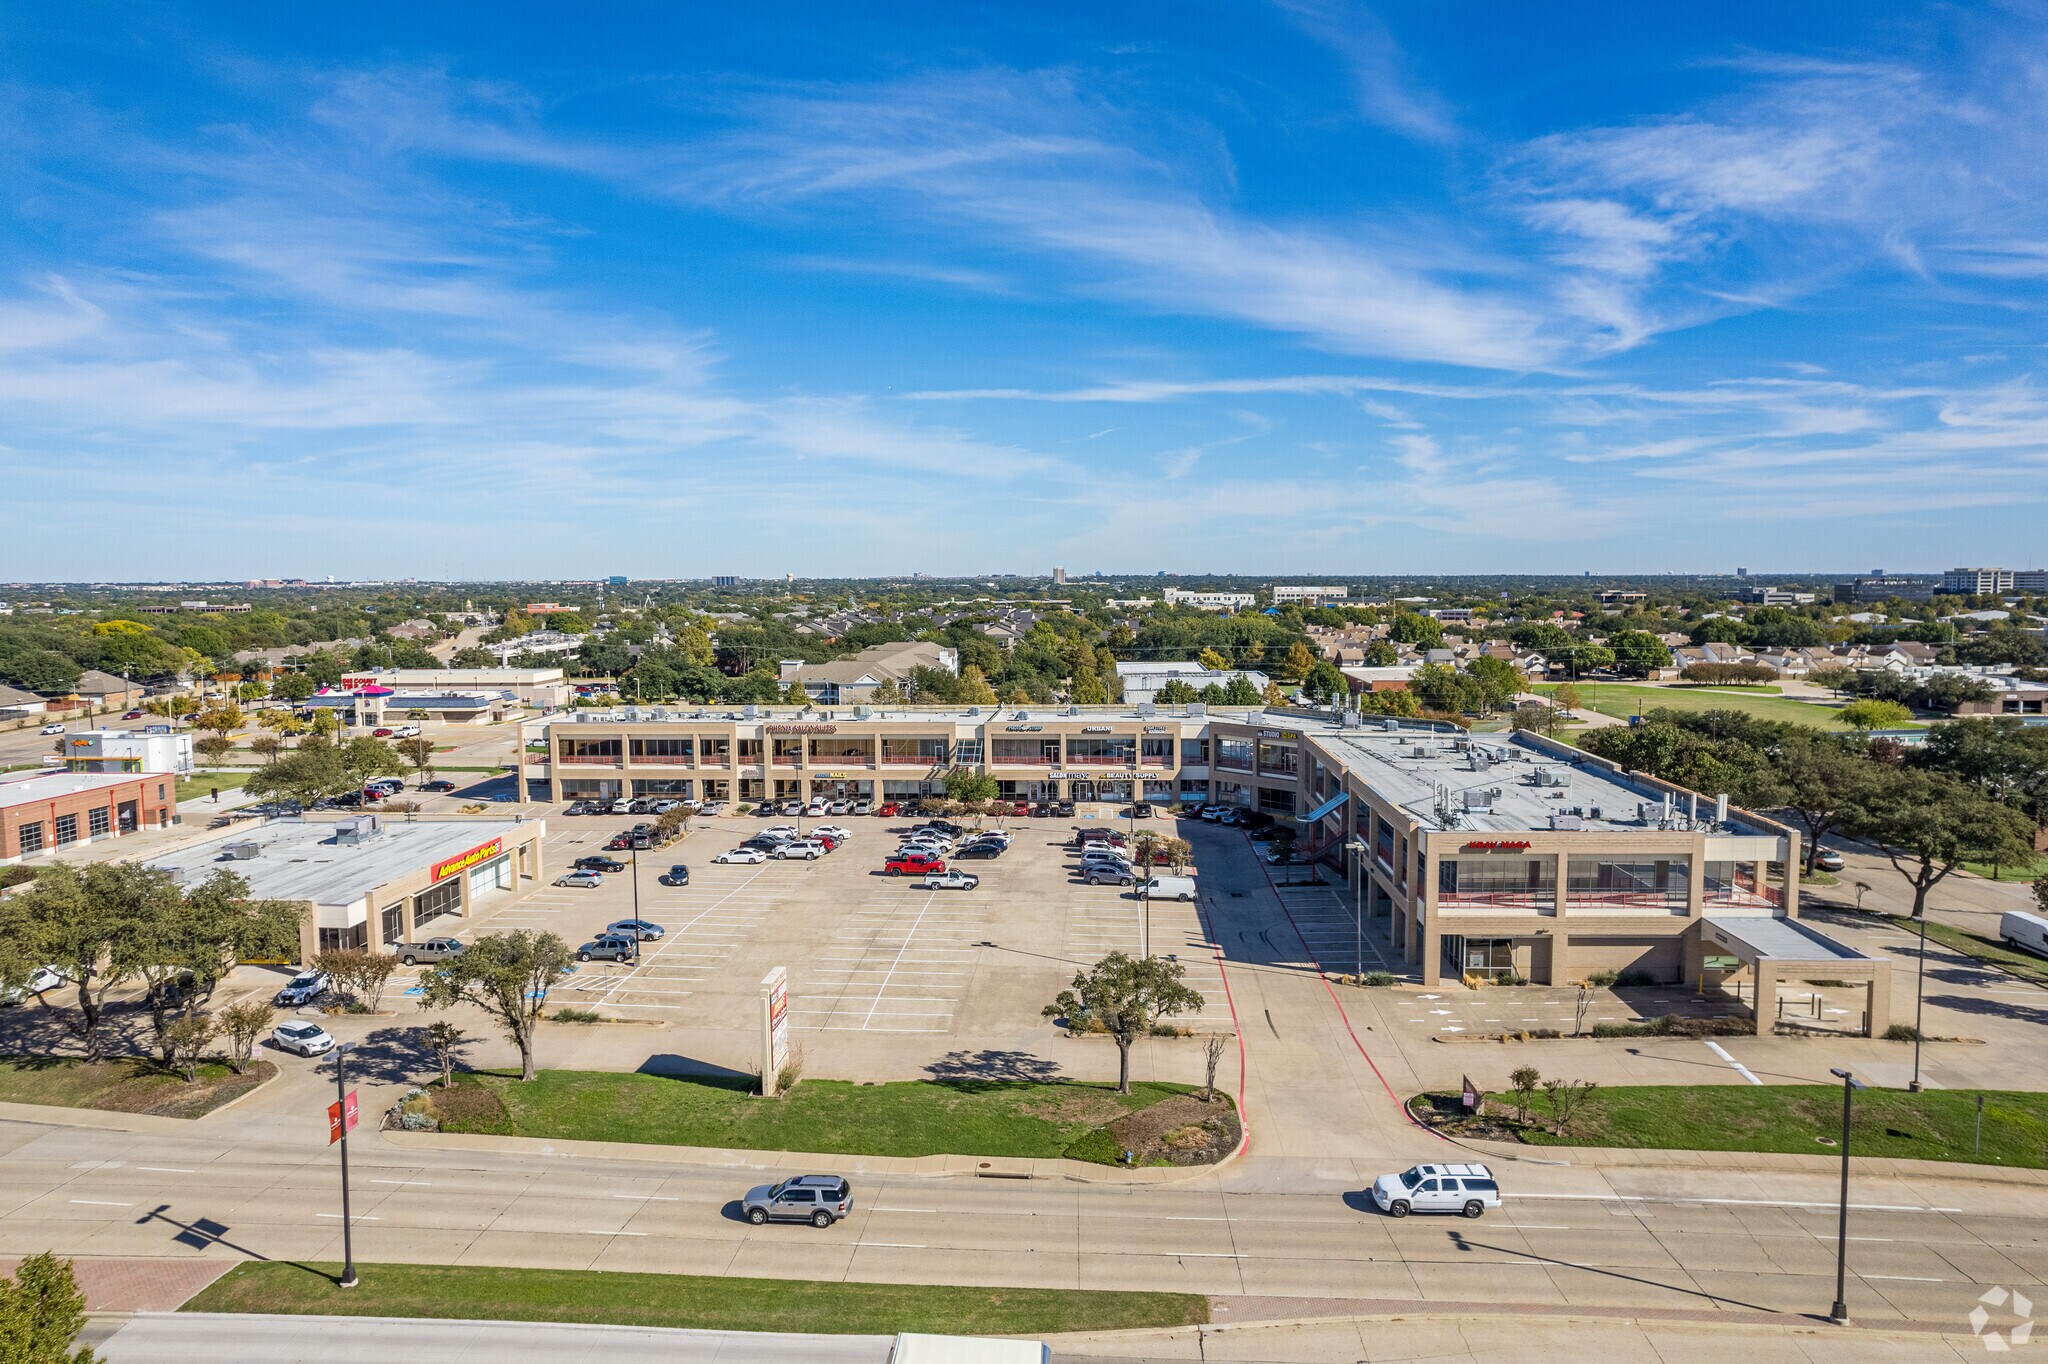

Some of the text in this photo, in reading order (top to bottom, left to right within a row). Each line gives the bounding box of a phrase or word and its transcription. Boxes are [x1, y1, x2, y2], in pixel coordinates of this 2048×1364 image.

[1263, 730, 1280, 738] STUDIO
[438, 842, 497, 879] Advance Auto Parts
